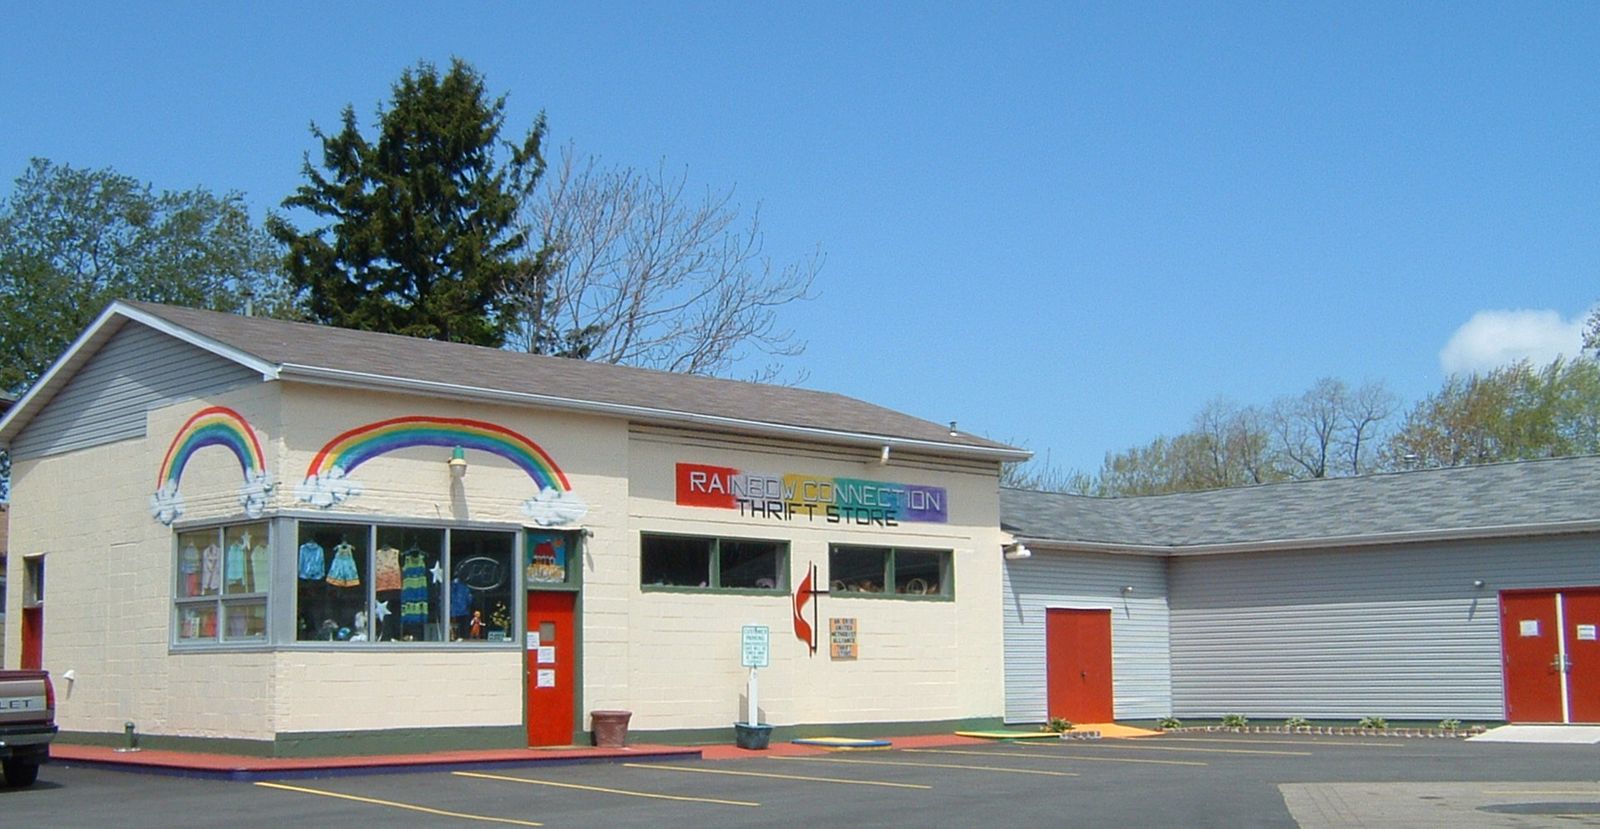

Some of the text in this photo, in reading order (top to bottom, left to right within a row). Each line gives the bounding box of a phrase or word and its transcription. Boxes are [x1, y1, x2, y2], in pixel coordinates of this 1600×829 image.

[689, 471, 941, 511] RAINBOW CONNECTION
[736, 498, 899, 527] THRIFT STORE
